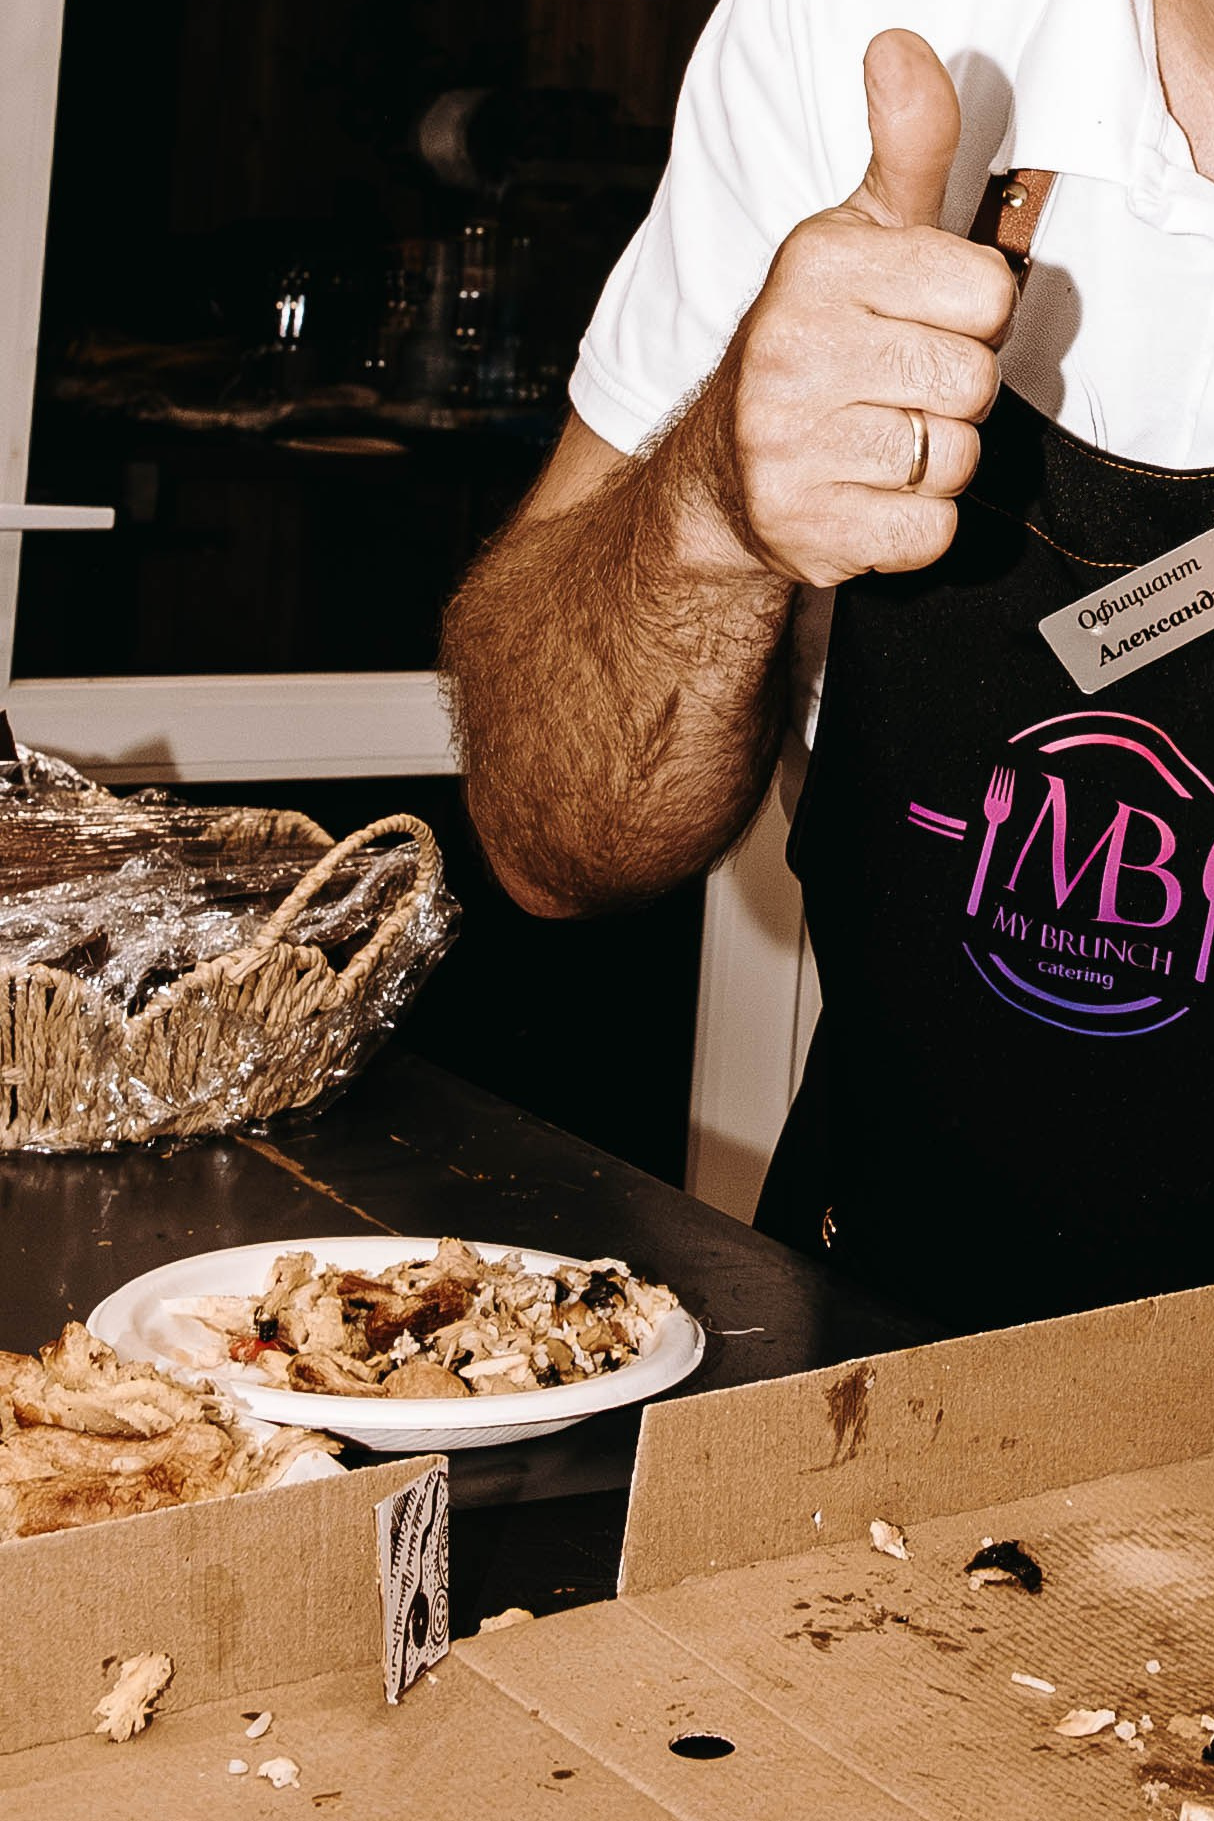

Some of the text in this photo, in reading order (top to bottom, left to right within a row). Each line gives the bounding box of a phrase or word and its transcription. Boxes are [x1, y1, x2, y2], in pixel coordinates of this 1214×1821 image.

[1077, 558, 1202, 630] Официант
[1002, 772, 1182, 928] MB
[992, 906, 1174, 976] MY BRUNCH
[1038, 958, 1114, 990] catering
